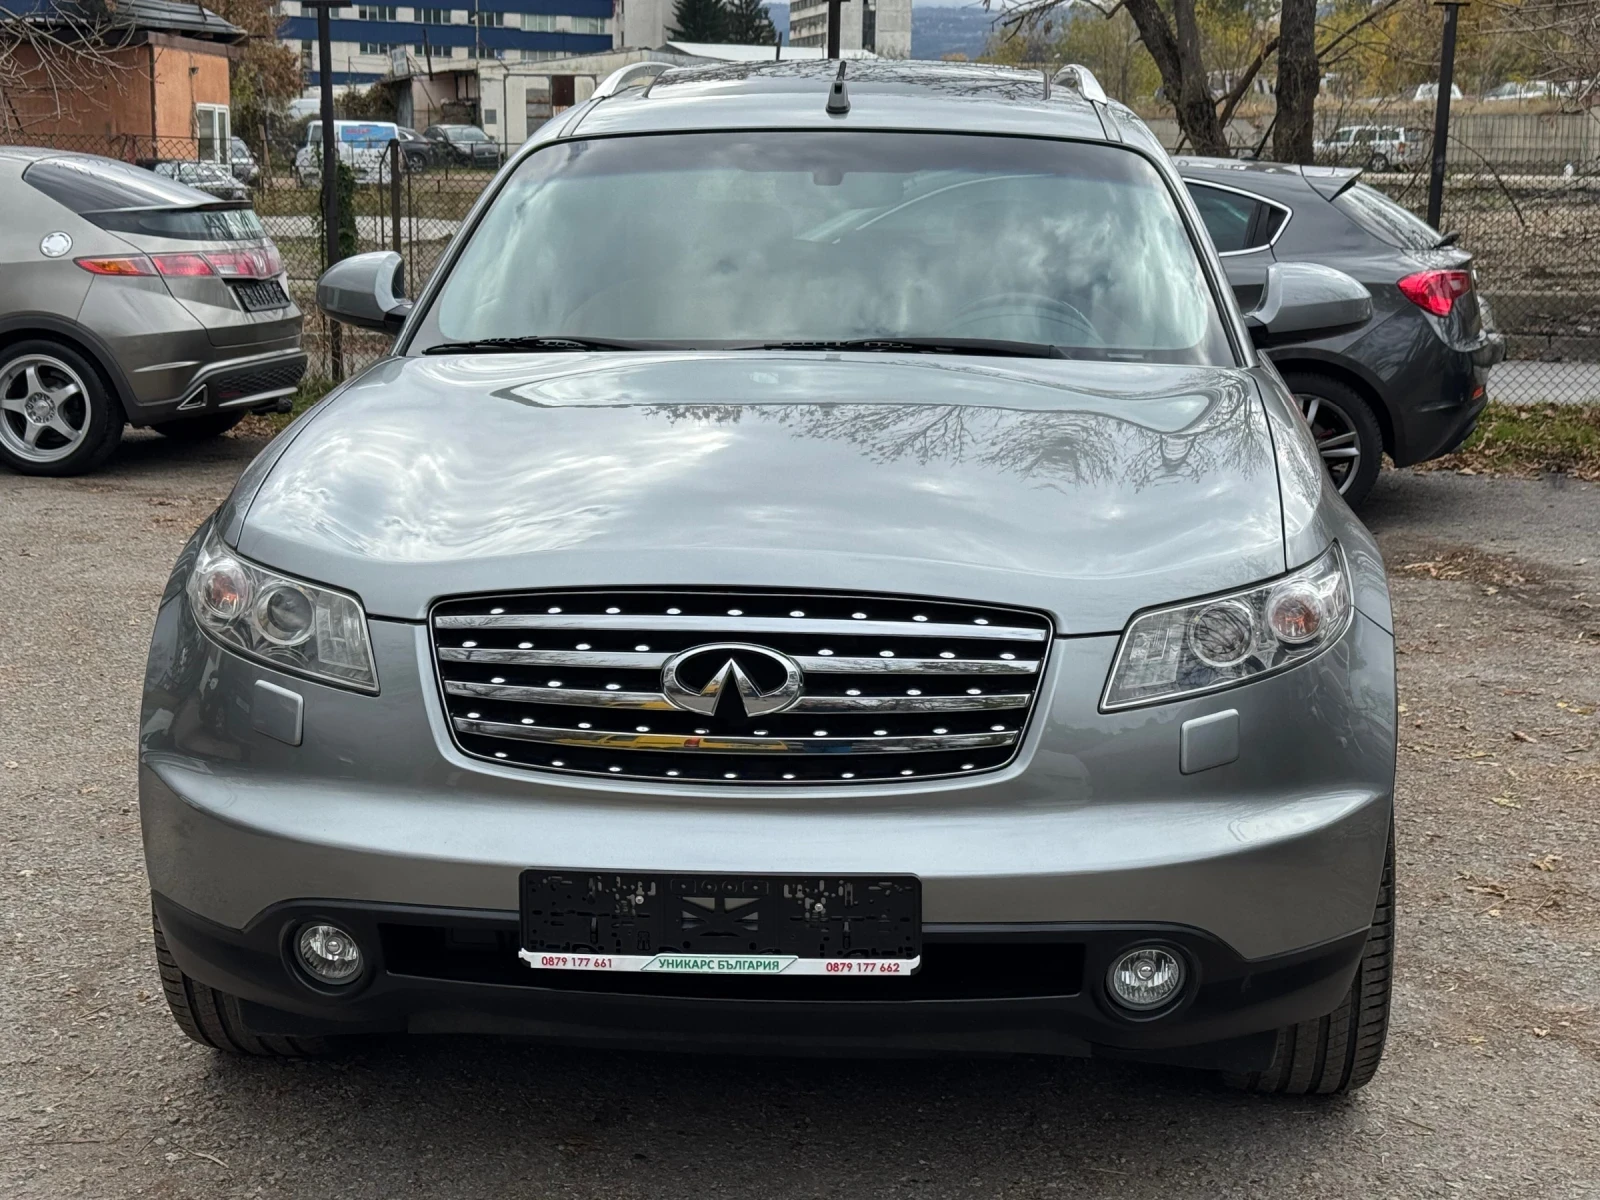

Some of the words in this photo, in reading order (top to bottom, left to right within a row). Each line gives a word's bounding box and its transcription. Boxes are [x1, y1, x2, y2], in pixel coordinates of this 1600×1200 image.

[541, 956, 567, 967] 0879
[571, 957, 590, 967] 177
[593, 957, 612, 968] 661
[658, 958, 715, 970] УНИКАРС
[717, 960, 780, 971] БЪЛГАРИЯ
[826, 962, 853, 972] 0879
[858, 962, 876, 973] 177
[879, 963, 900, 973] 662
